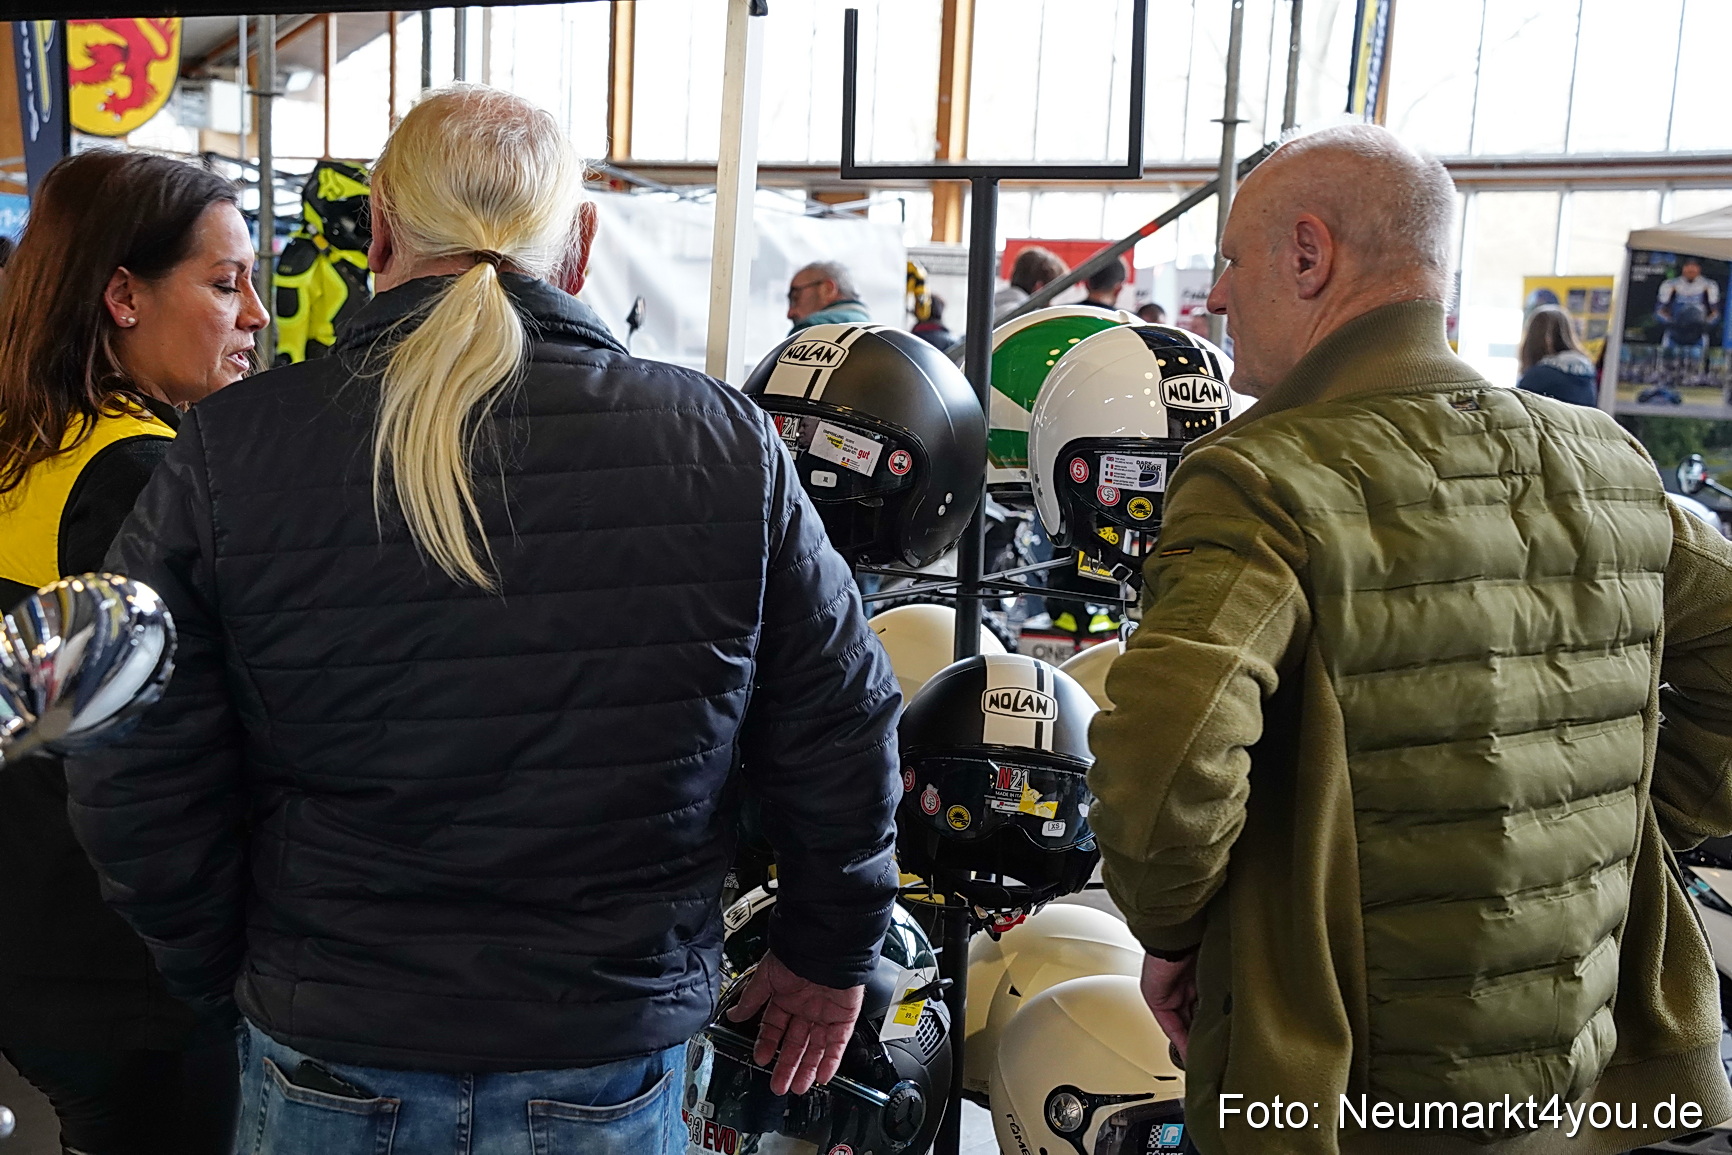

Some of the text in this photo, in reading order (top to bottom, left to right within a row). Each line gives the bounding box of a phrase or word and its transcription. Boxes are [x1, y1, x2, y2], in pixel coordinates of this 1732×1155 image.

[783, 342, 839, 364] NOLAN
[1168, 378, 1223, 405] NOLAN
[856, 449, 871, 460] gut
[1075, 464, 1083, 477] 5
[1139, 464, 1162, 472] VISOR
[988, 689, 1048, 716] NOLAN
[904, 772, 911, 785] 5
[996, 766, 1030, 792] N21
[1050, 822, 1060, 830] XS
[703, 1120, 737, 1155] EVO
